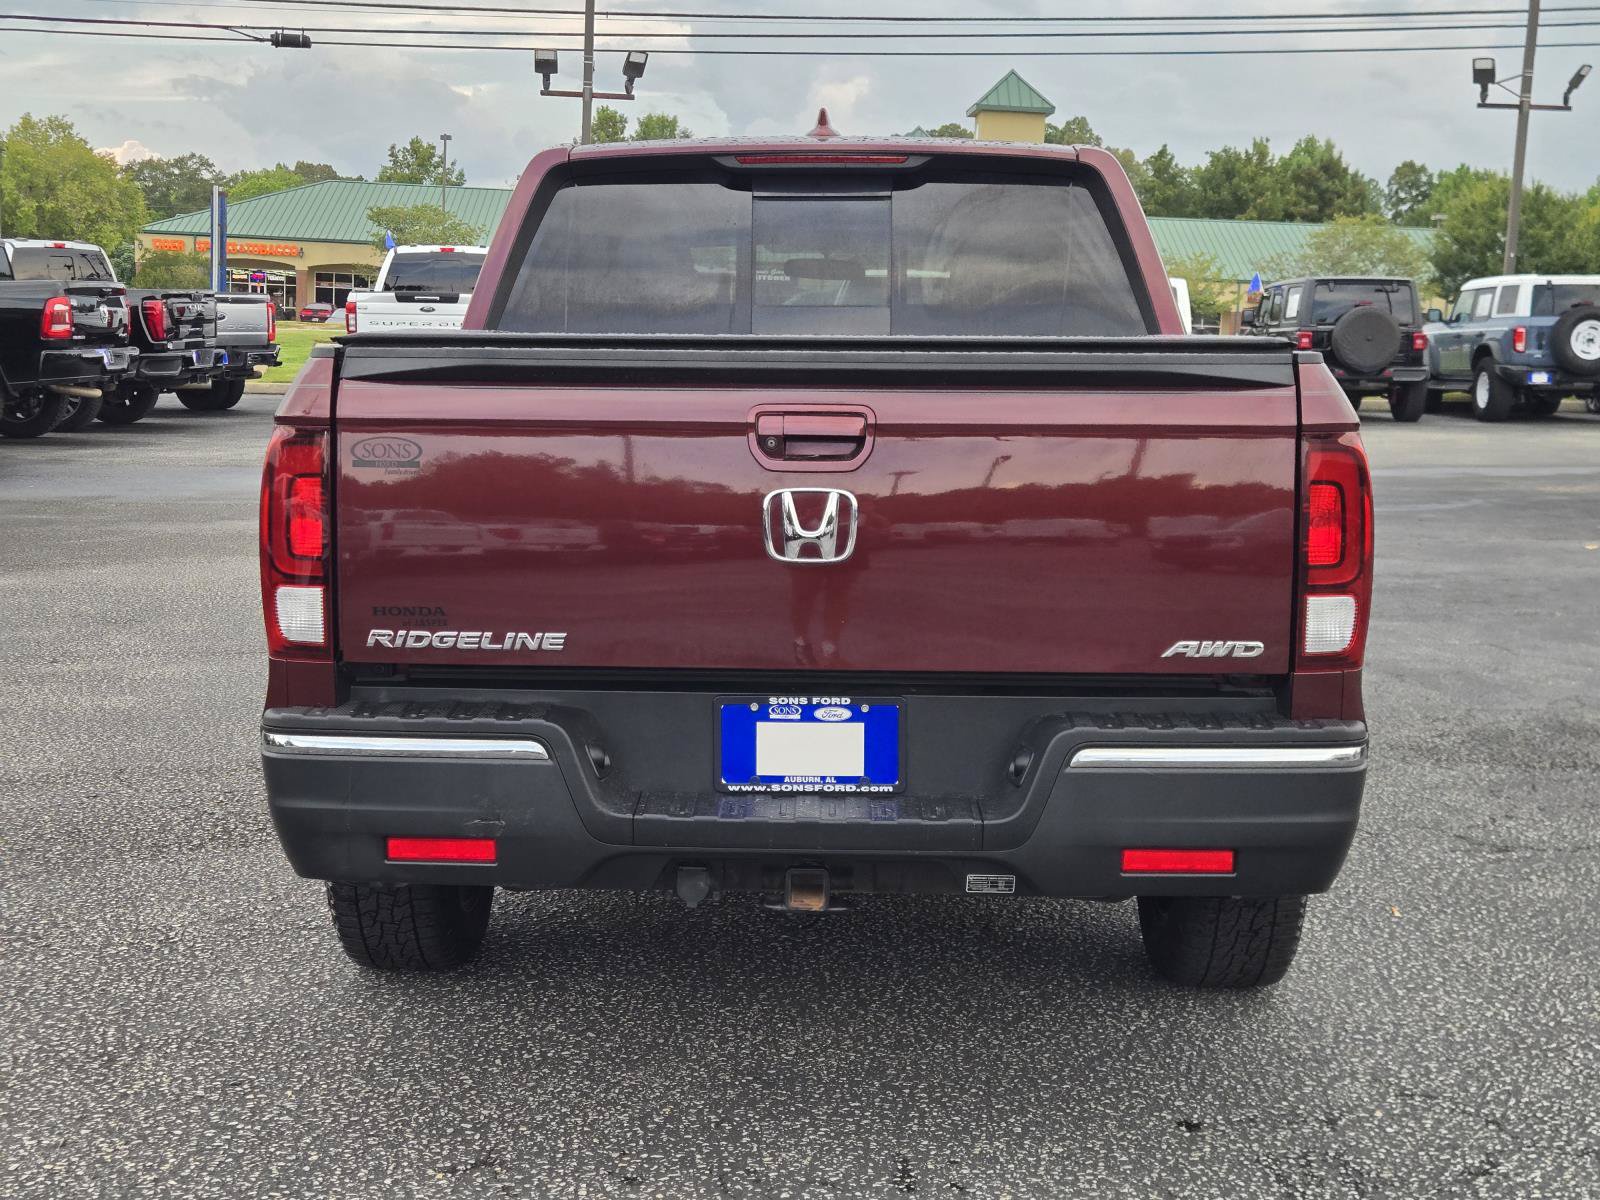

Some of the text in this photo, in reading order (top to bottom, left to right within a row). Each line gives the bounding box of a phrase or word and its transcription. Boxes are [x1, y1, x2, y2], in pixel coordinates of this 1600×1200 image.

[361, 442, 412, 459] SONS
[372, 606, 446, 616] HONDA
[366, 629, 568, 651] RIDGELINE
[1160, 640, 1265, 658] AWD
[768, 697, 851, 705] SONS FORD
[772, 706, 797, 716] SONS
[820, 709, 844, 720] Ford
[783, 776, 837, 785] AUBURN, AL
[727, 784, 894, 792] www.SONSFORD.com
